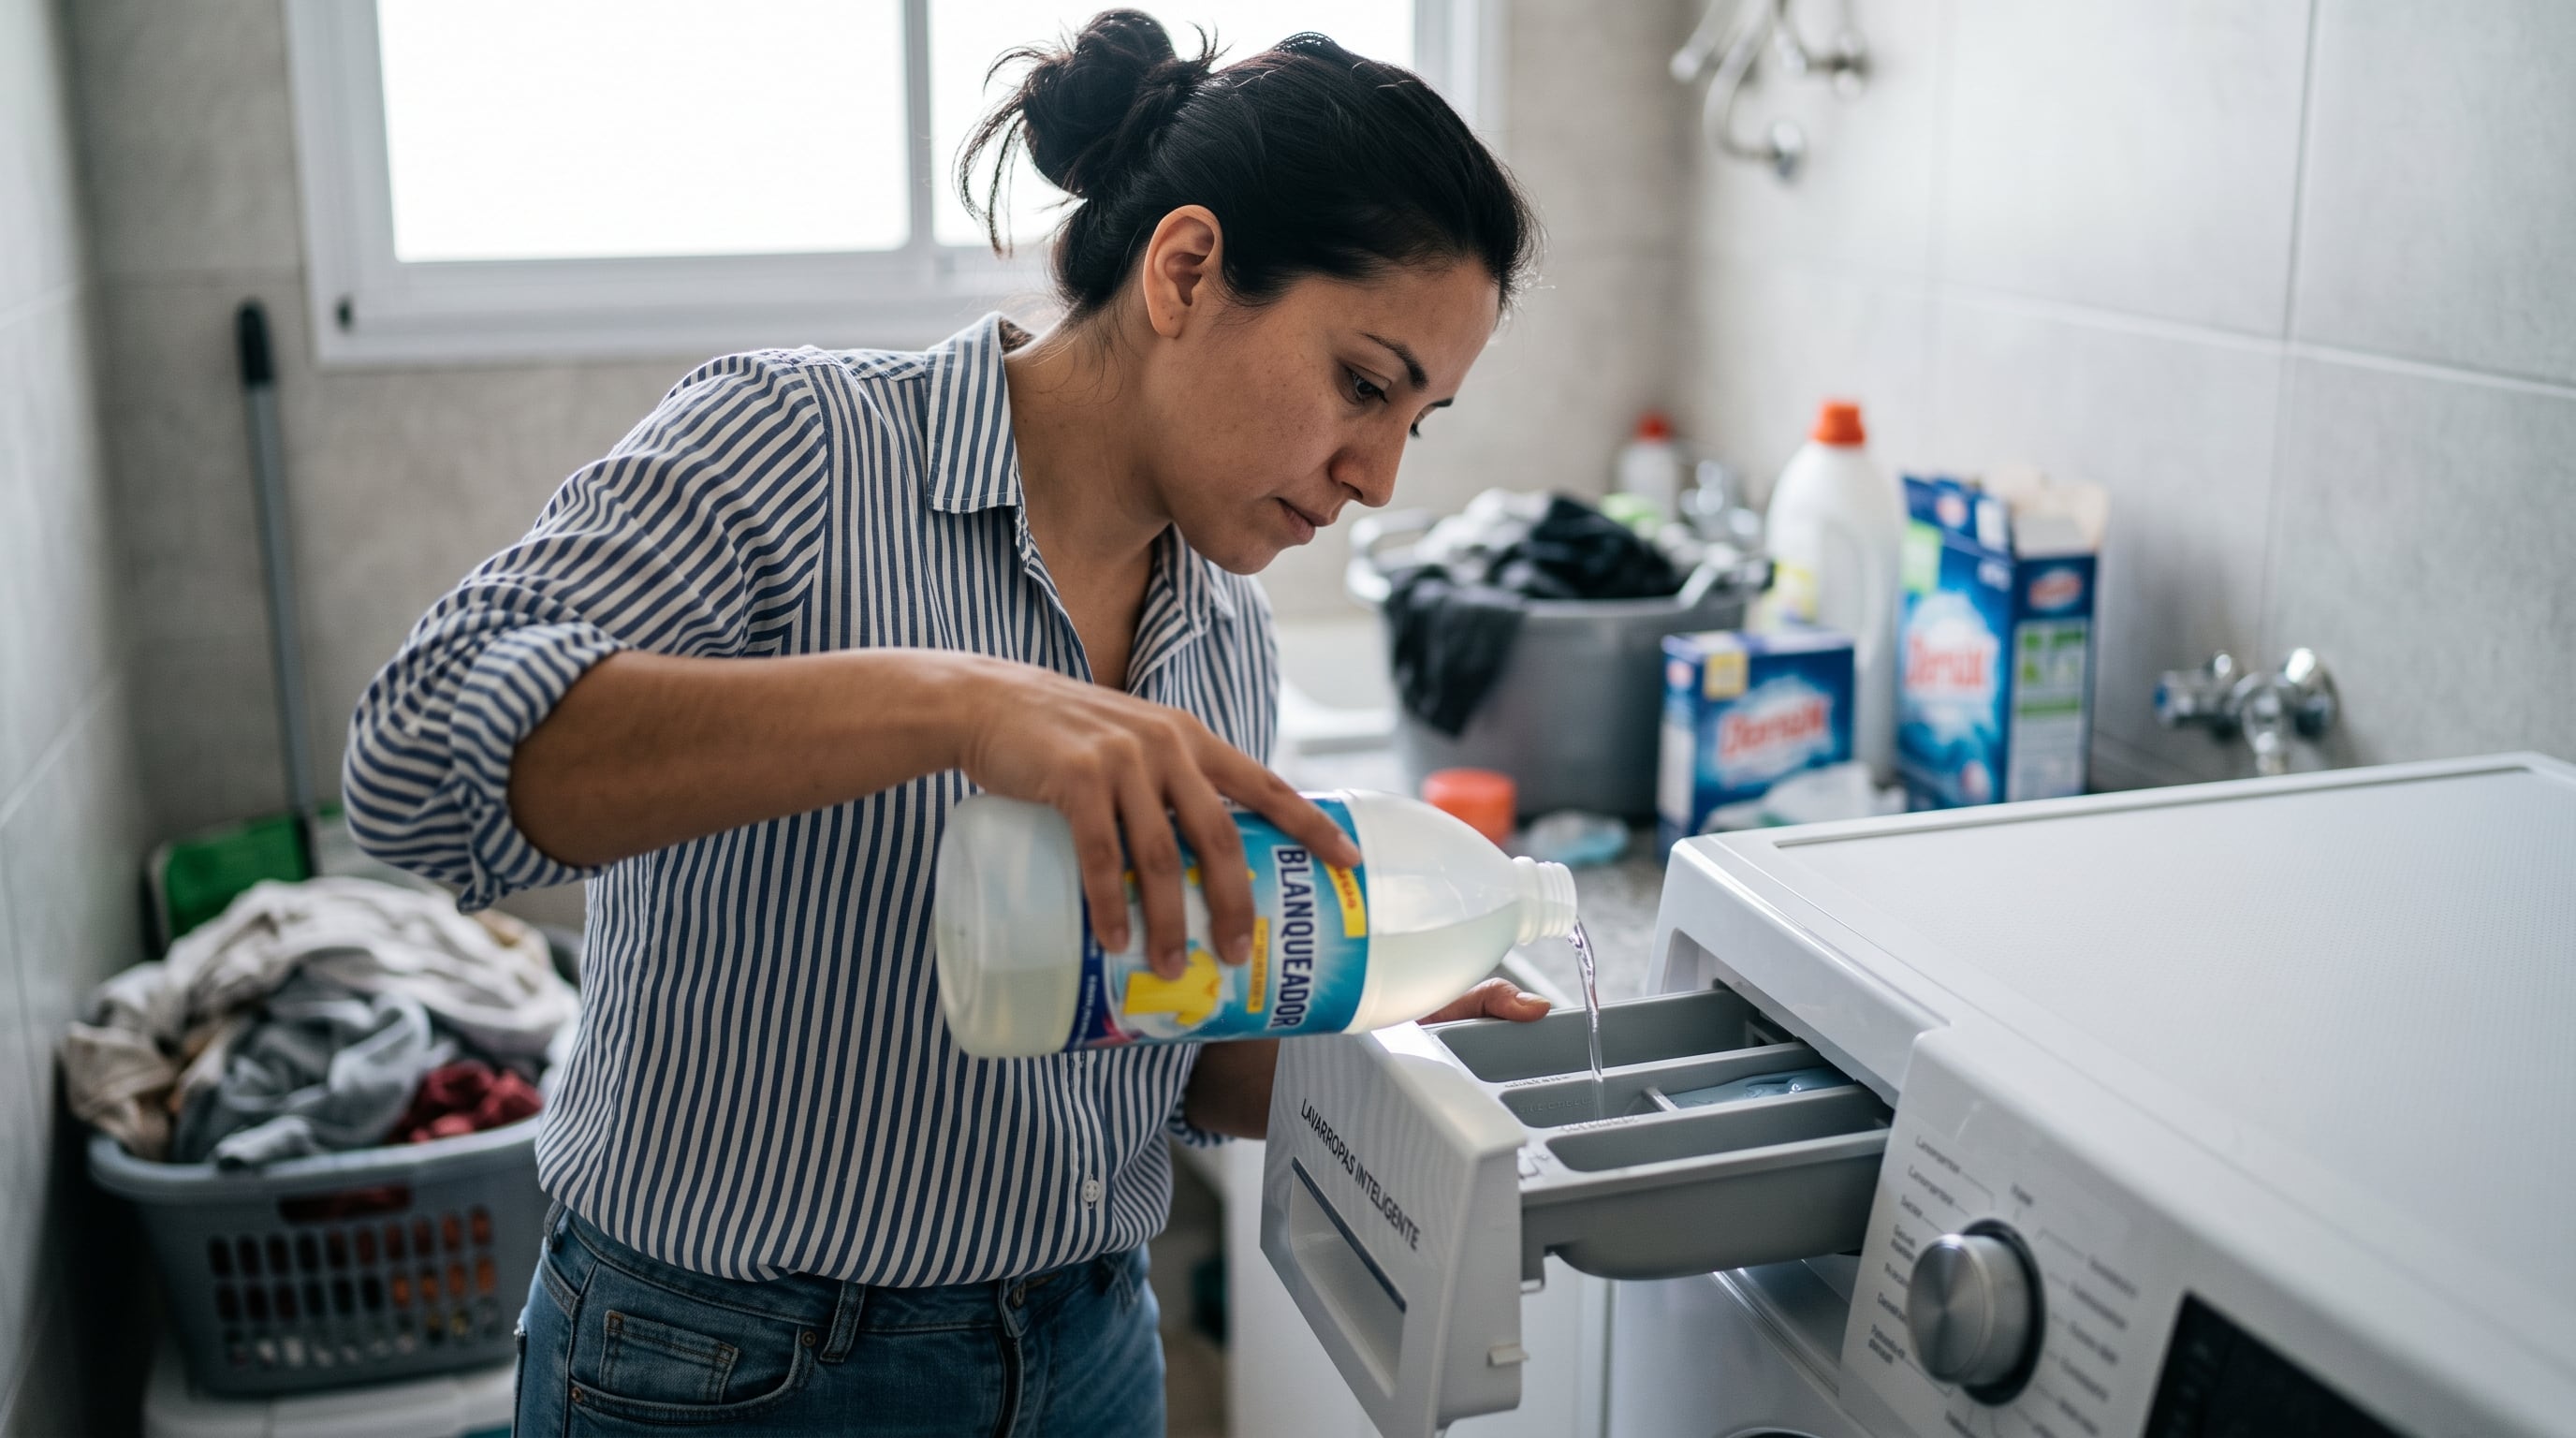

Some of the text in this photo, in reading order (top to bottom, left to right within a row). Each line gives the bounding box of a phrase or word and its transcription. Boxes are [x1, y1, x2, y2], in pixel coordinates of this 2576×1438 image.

[1270, 848, 1314, 1028] BLANQUEADOR
[1300, 1098, 1420, 1252] LAVARROPAS INTELIGENTE
